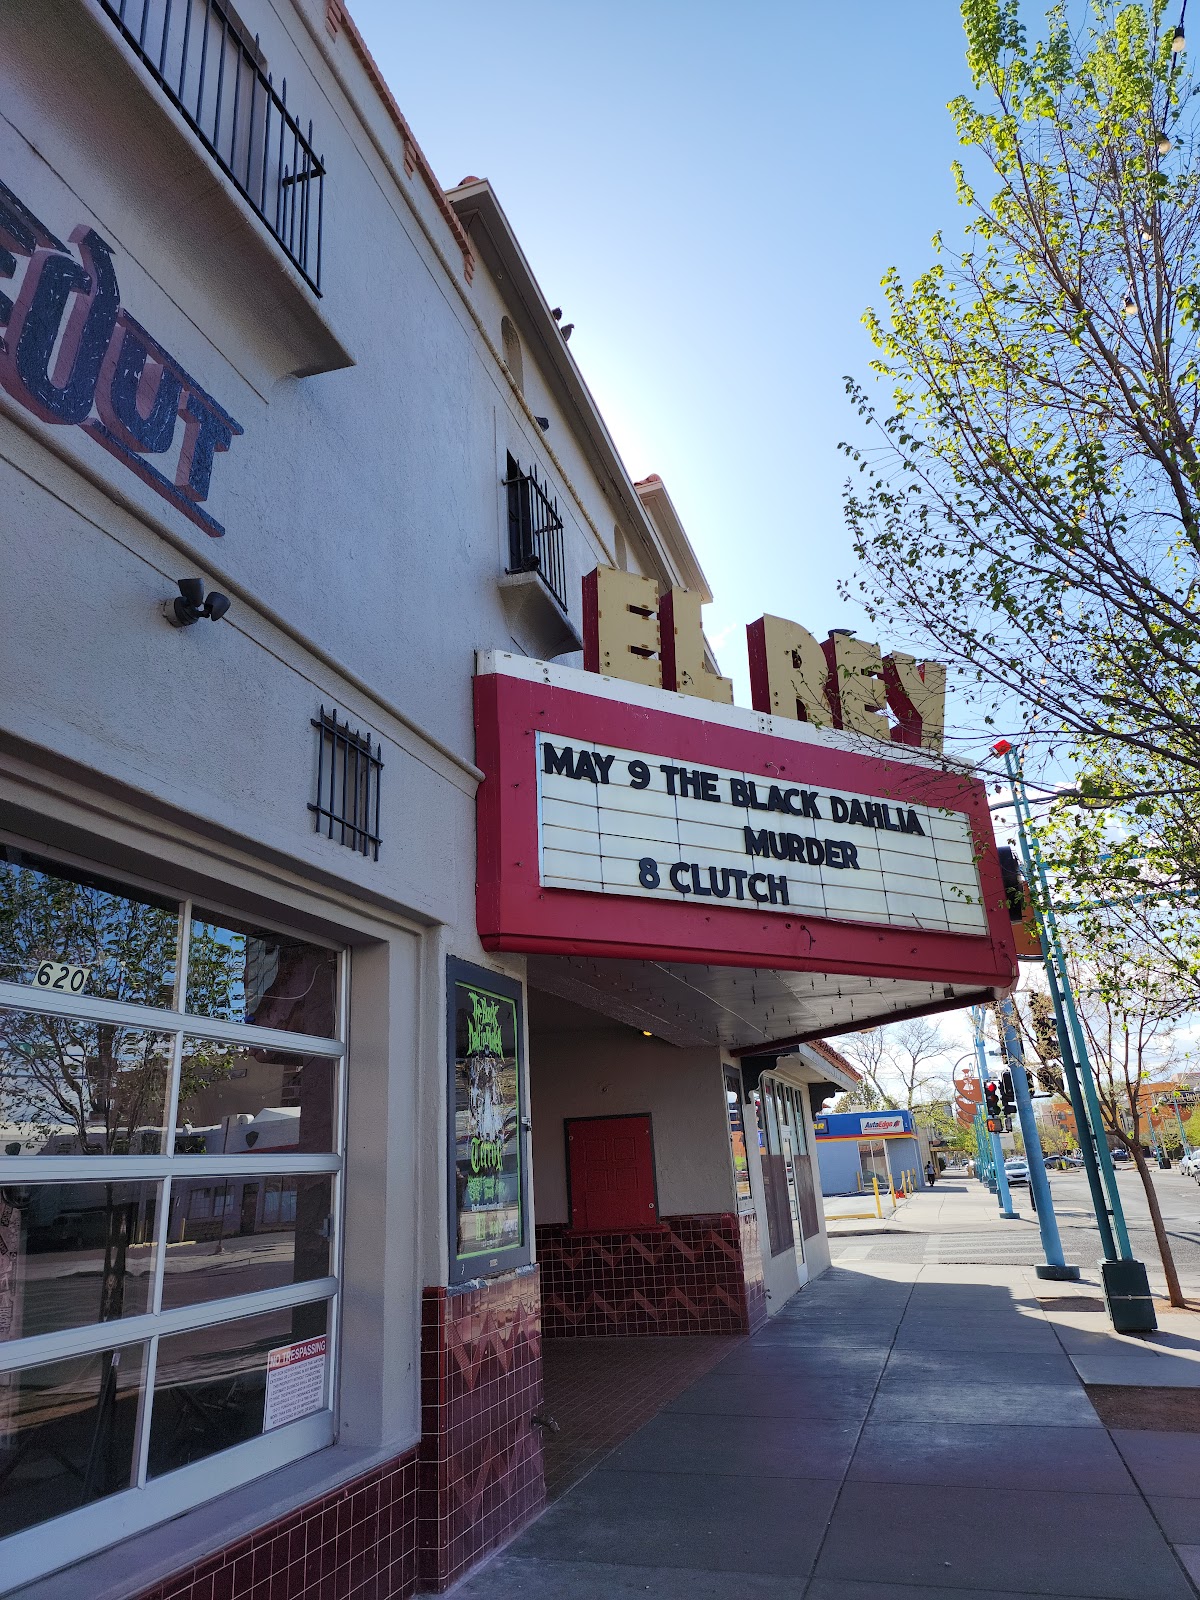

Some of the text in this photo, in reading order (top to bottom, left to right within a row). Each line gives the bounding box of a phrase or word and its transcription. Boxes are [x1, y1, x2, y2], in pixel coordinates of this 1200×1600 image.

[582, 564, 946, 750] EL REY
[543, 742, 925, 836] MAY 9 THE BLACK DAHLIA
[743, 826, 860, 870] MURDER
[639, 857, 789, 906] 8 CLUTCH
[37, 963, 85, 991] 620
[270, 1340, 326, 1368] NO TRESPASSING
